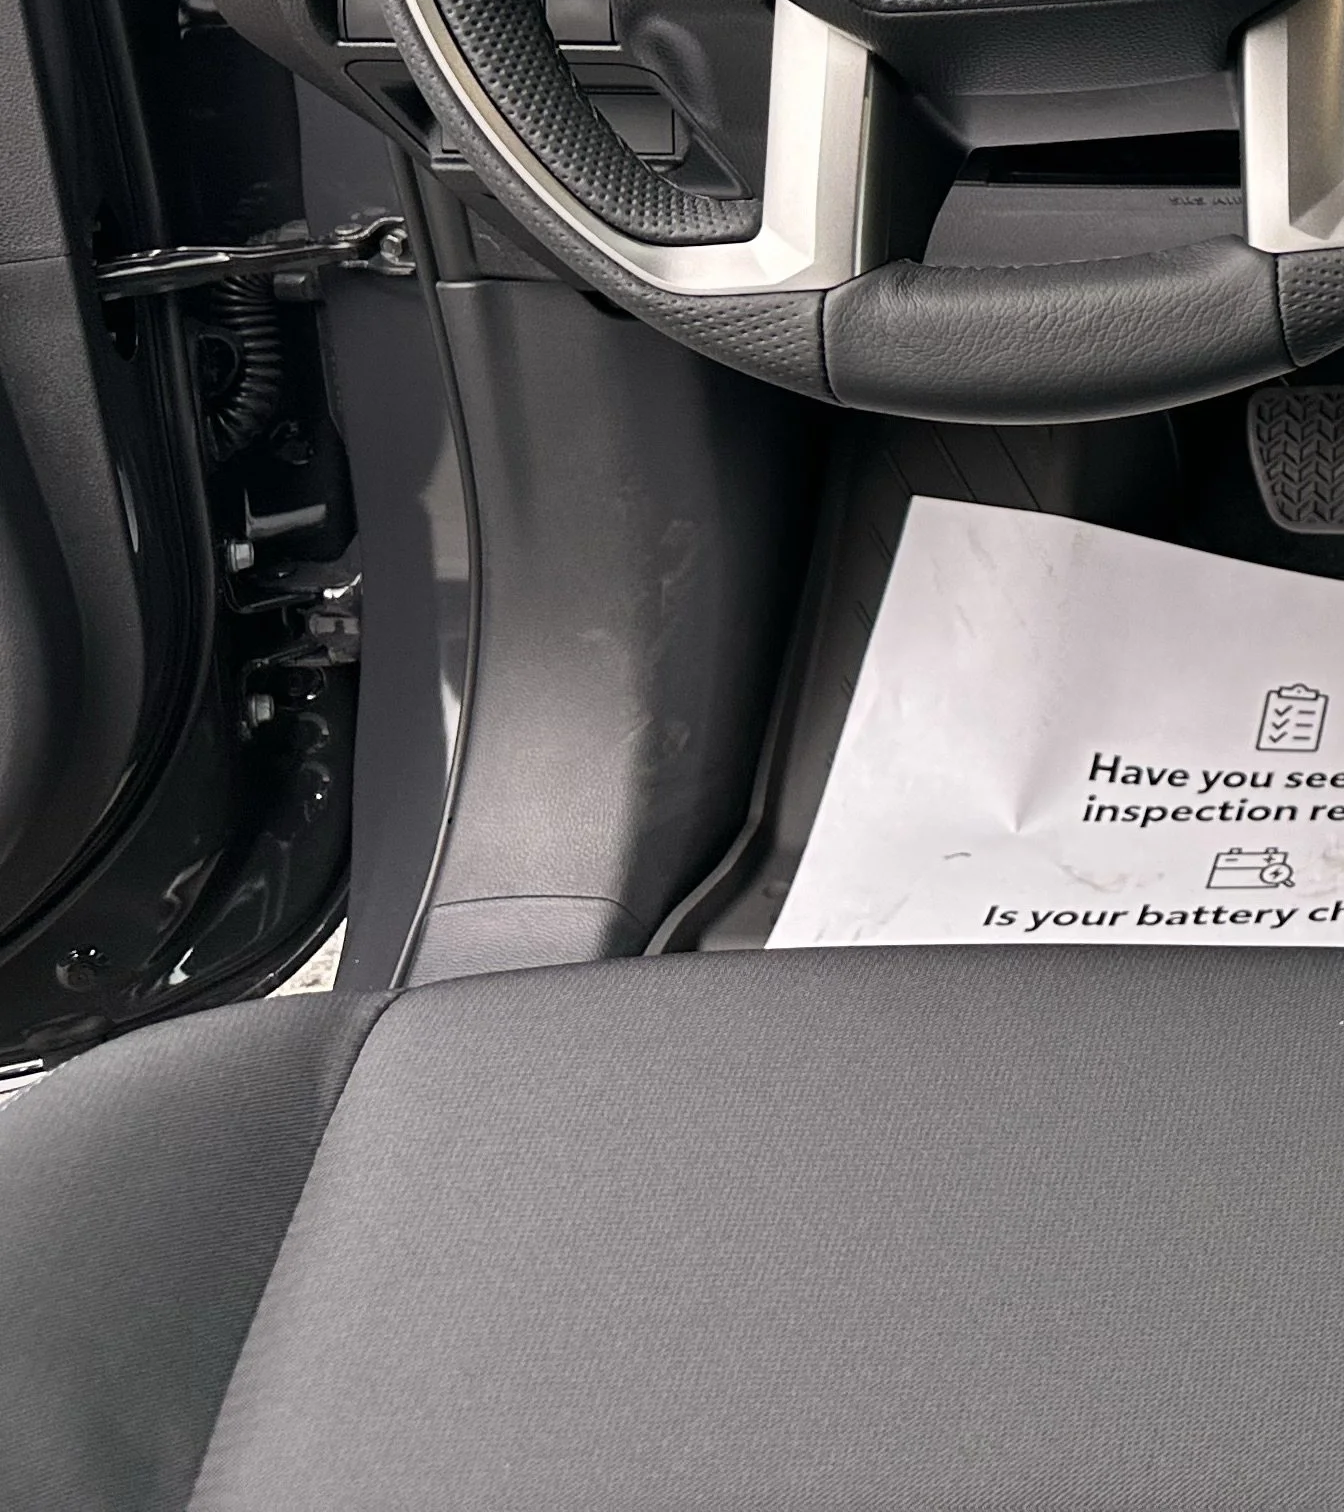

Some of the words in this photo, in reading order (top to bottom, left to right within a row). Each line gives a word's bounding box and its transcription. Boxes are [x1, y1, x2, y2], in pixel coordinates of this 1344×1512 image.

[1088, 751, 1191, 789] Have
[1199, 765, 1276, 794] you
[1081, 794, 1300, 828] inspection
[981, 904, 1019, 928] Is
[1024, 905, 1129, 933] your
[1137, 903, 1299, 930] battery
